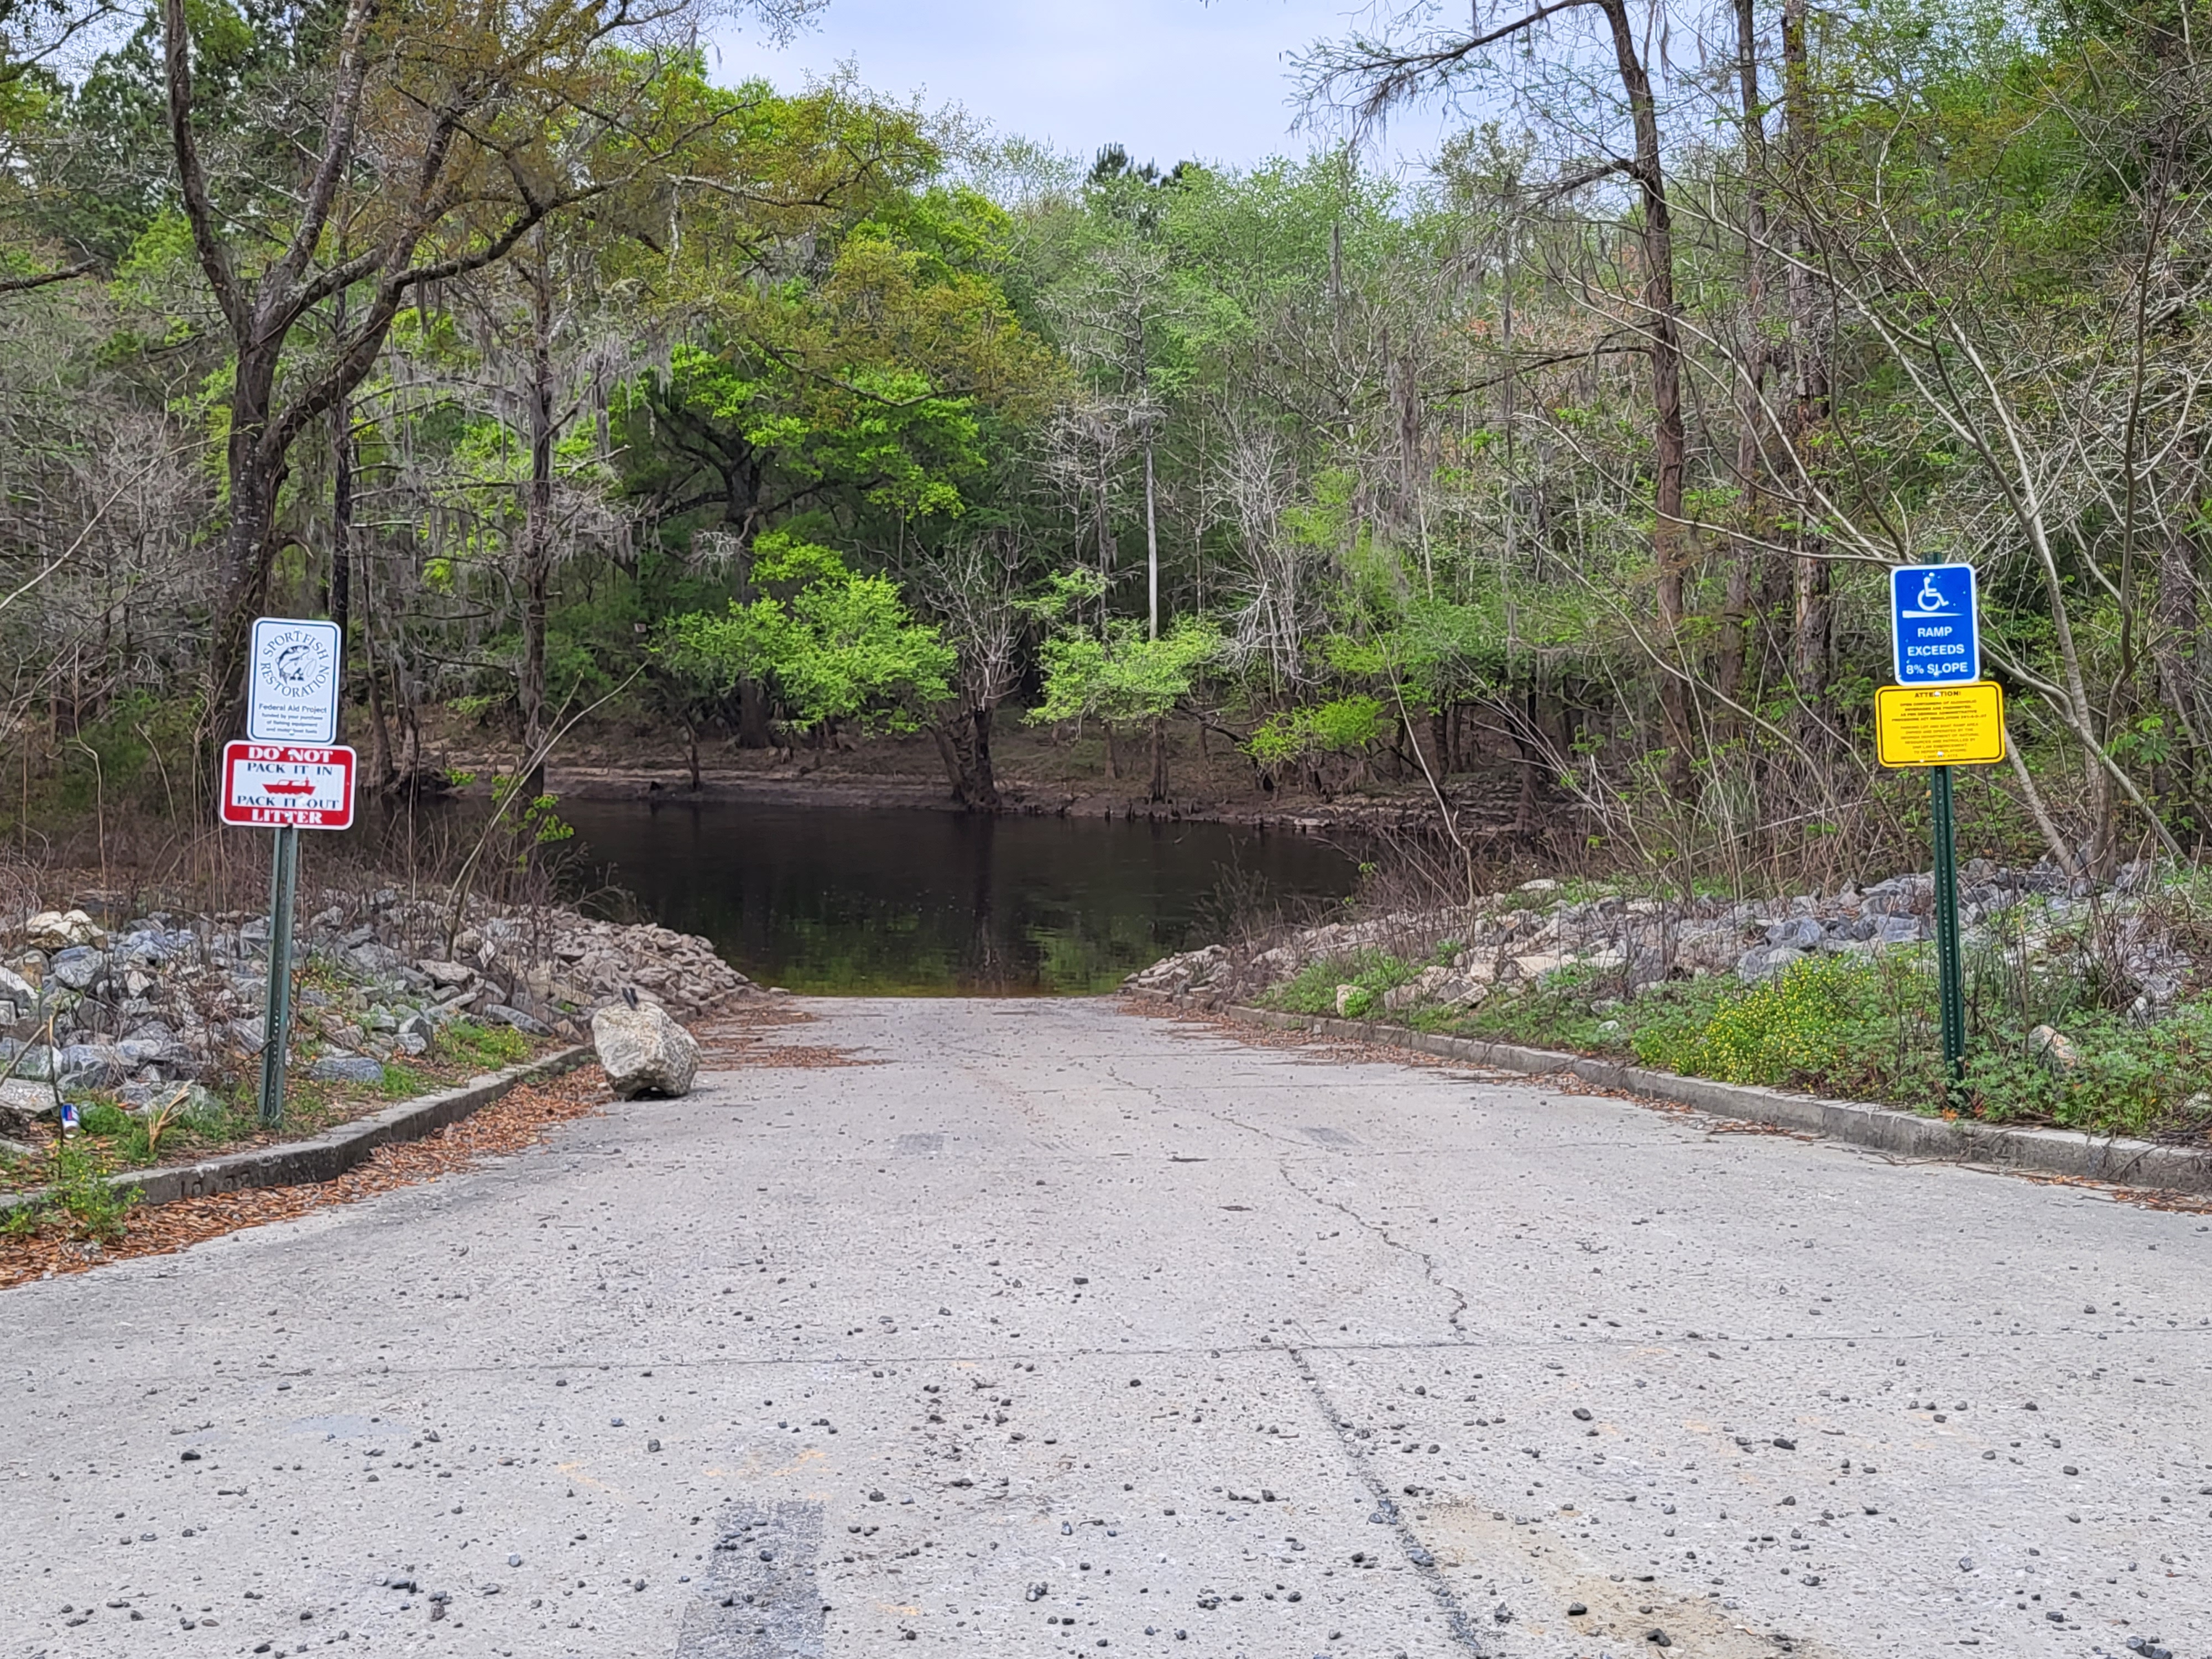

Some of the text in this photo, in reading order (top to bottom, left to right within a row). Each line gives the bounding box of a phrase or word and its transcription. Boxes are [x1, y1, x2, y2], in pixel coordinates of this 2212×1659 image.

[1917, 626, 1953, 638] RAMP
[302, 633, 329, 660] FISH
[1907, 643, 1965, 657] EXCEEDS
[1906, 661, 1968, 675] 8% SLOPE
[260, 662, 330, 697] RESTORATION
[259, 703, 286, 711] Federal
[302, 705, 327, 714] Project
[249, 746, 333, 763] DO NOT
[247, 763, 333, 775] PACK IT IN
[237, 795, 340, 809] PACK IT OUT
[252, 808, 323, 824] LITTER
